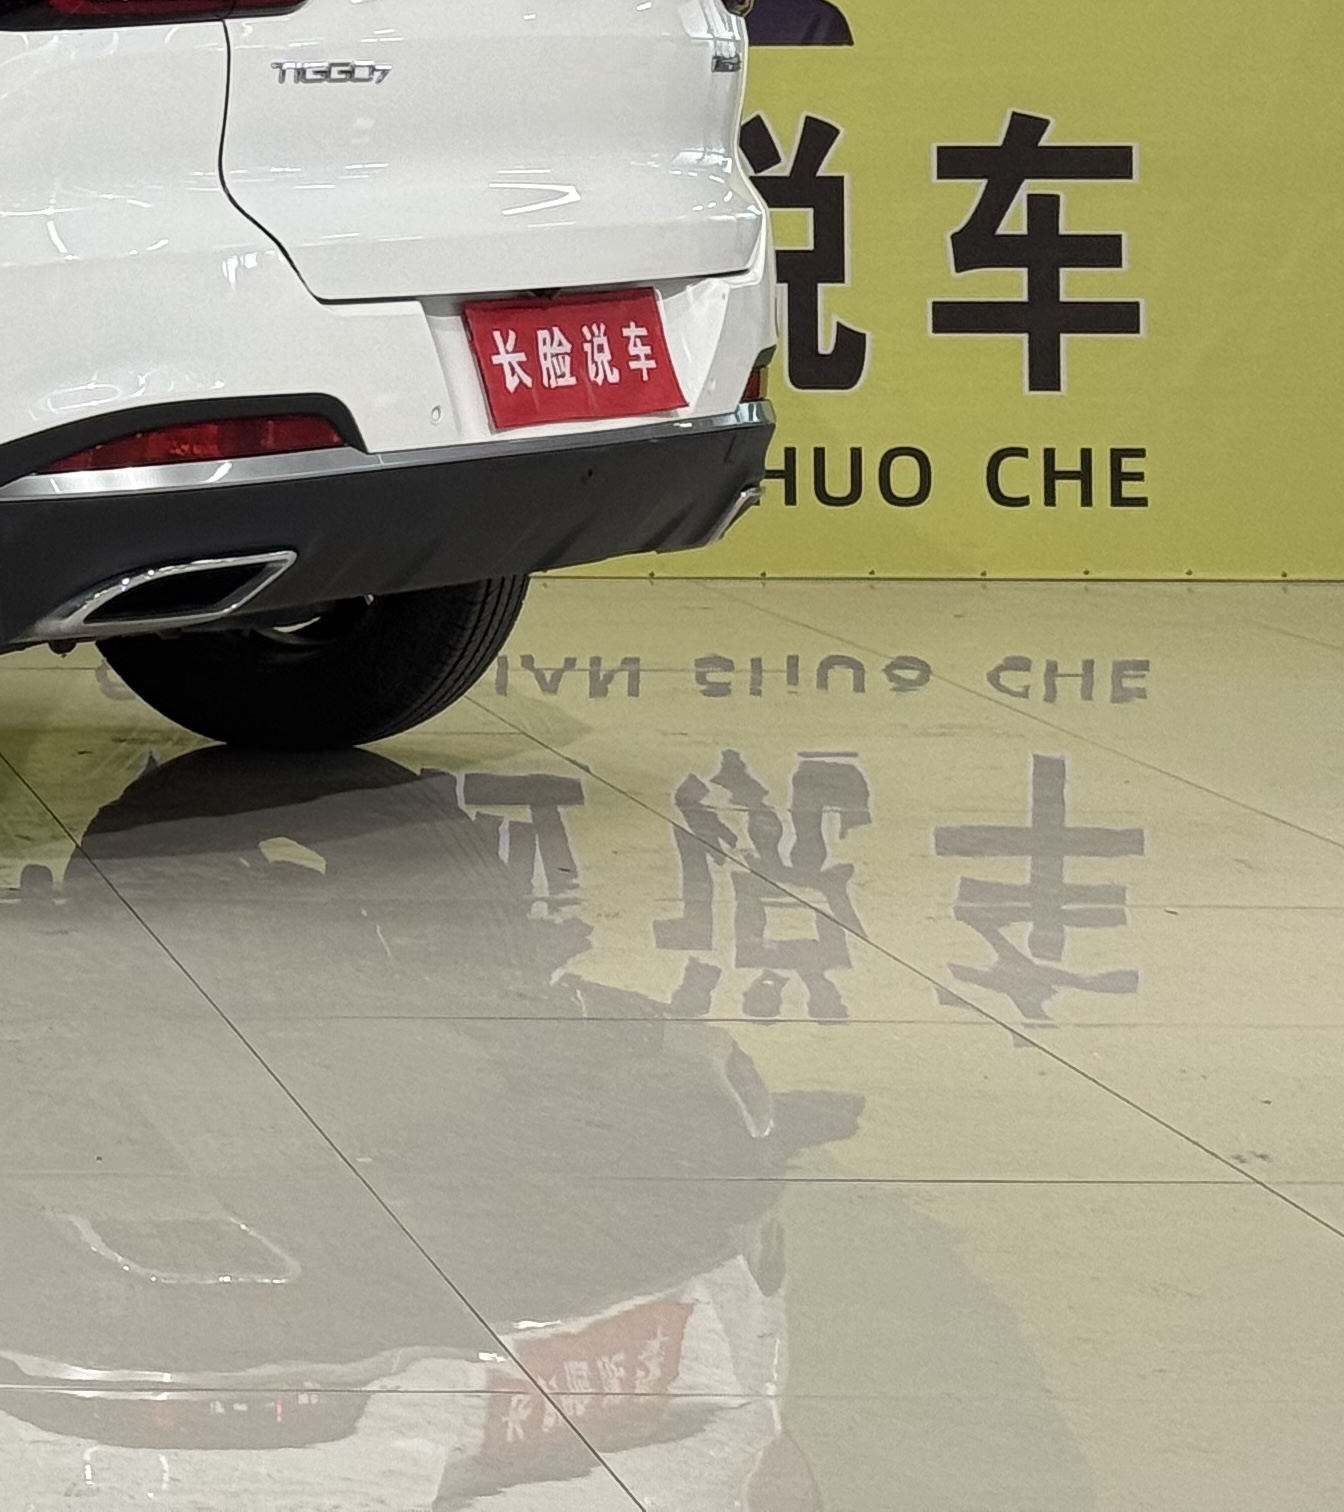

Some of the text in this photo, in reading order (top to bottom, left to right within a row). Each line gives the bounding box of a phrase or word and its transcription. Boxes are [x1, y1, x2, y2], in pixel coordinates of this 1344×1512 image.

[490, 320, 658, 394] 长脸说车
[756, 445, 1149, 508] HUO CHE
